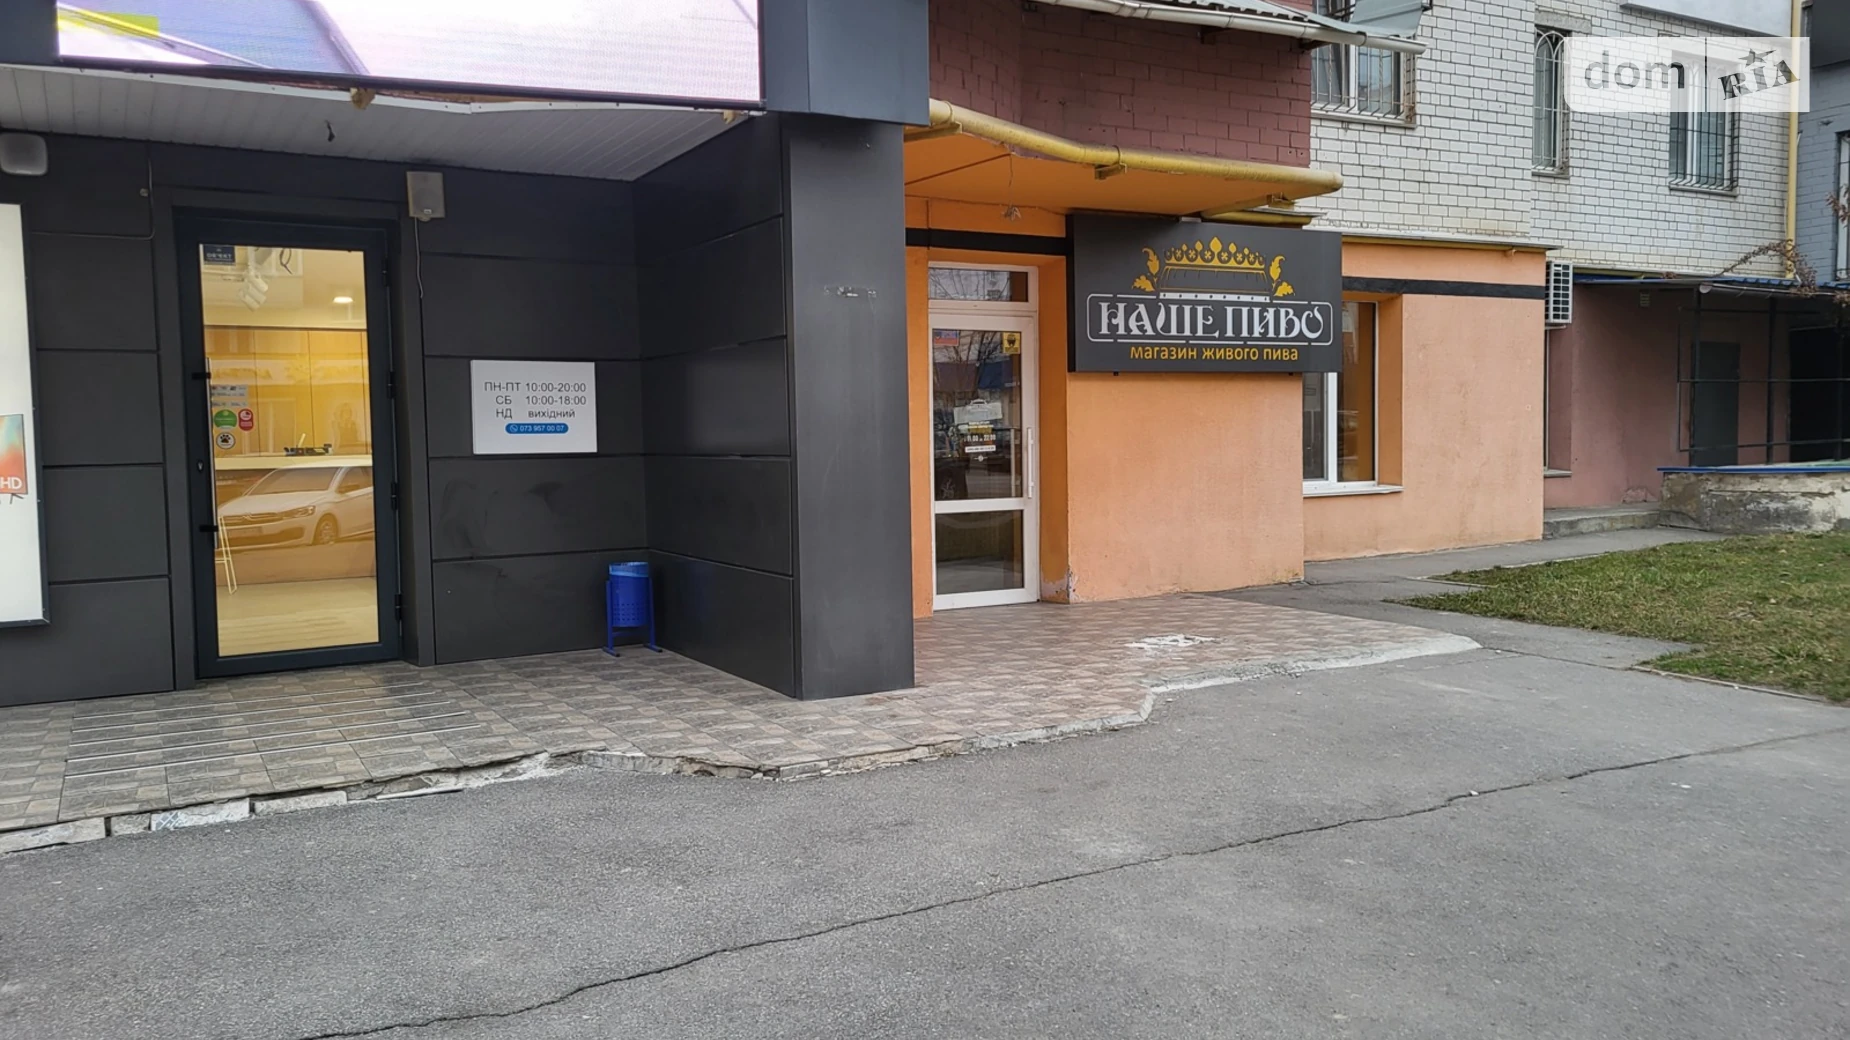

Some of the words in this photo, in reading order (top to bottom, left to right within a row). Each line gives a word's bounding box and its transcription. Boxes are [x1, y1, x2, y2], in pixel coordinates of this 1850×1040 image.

[1098, 302, 1219, 339] НАШЕ
[1224, 305, 1324, 339] ПИВО
[1130, 345, 1197, 360] магазин
[1202, 346, 1259, 361] живого
[1263, 347, 1298, 361] пива
[484, 381, 521, 392] ПН-ПТ
[525, 382, 587, 393] 10:00-20:00
[495, 395, 512, 405] СБ
[525, 395, 587, 405] 10:00-18:00
[496, 408, 512, 419] НД
[528, 409, 575, 419] вихідний
